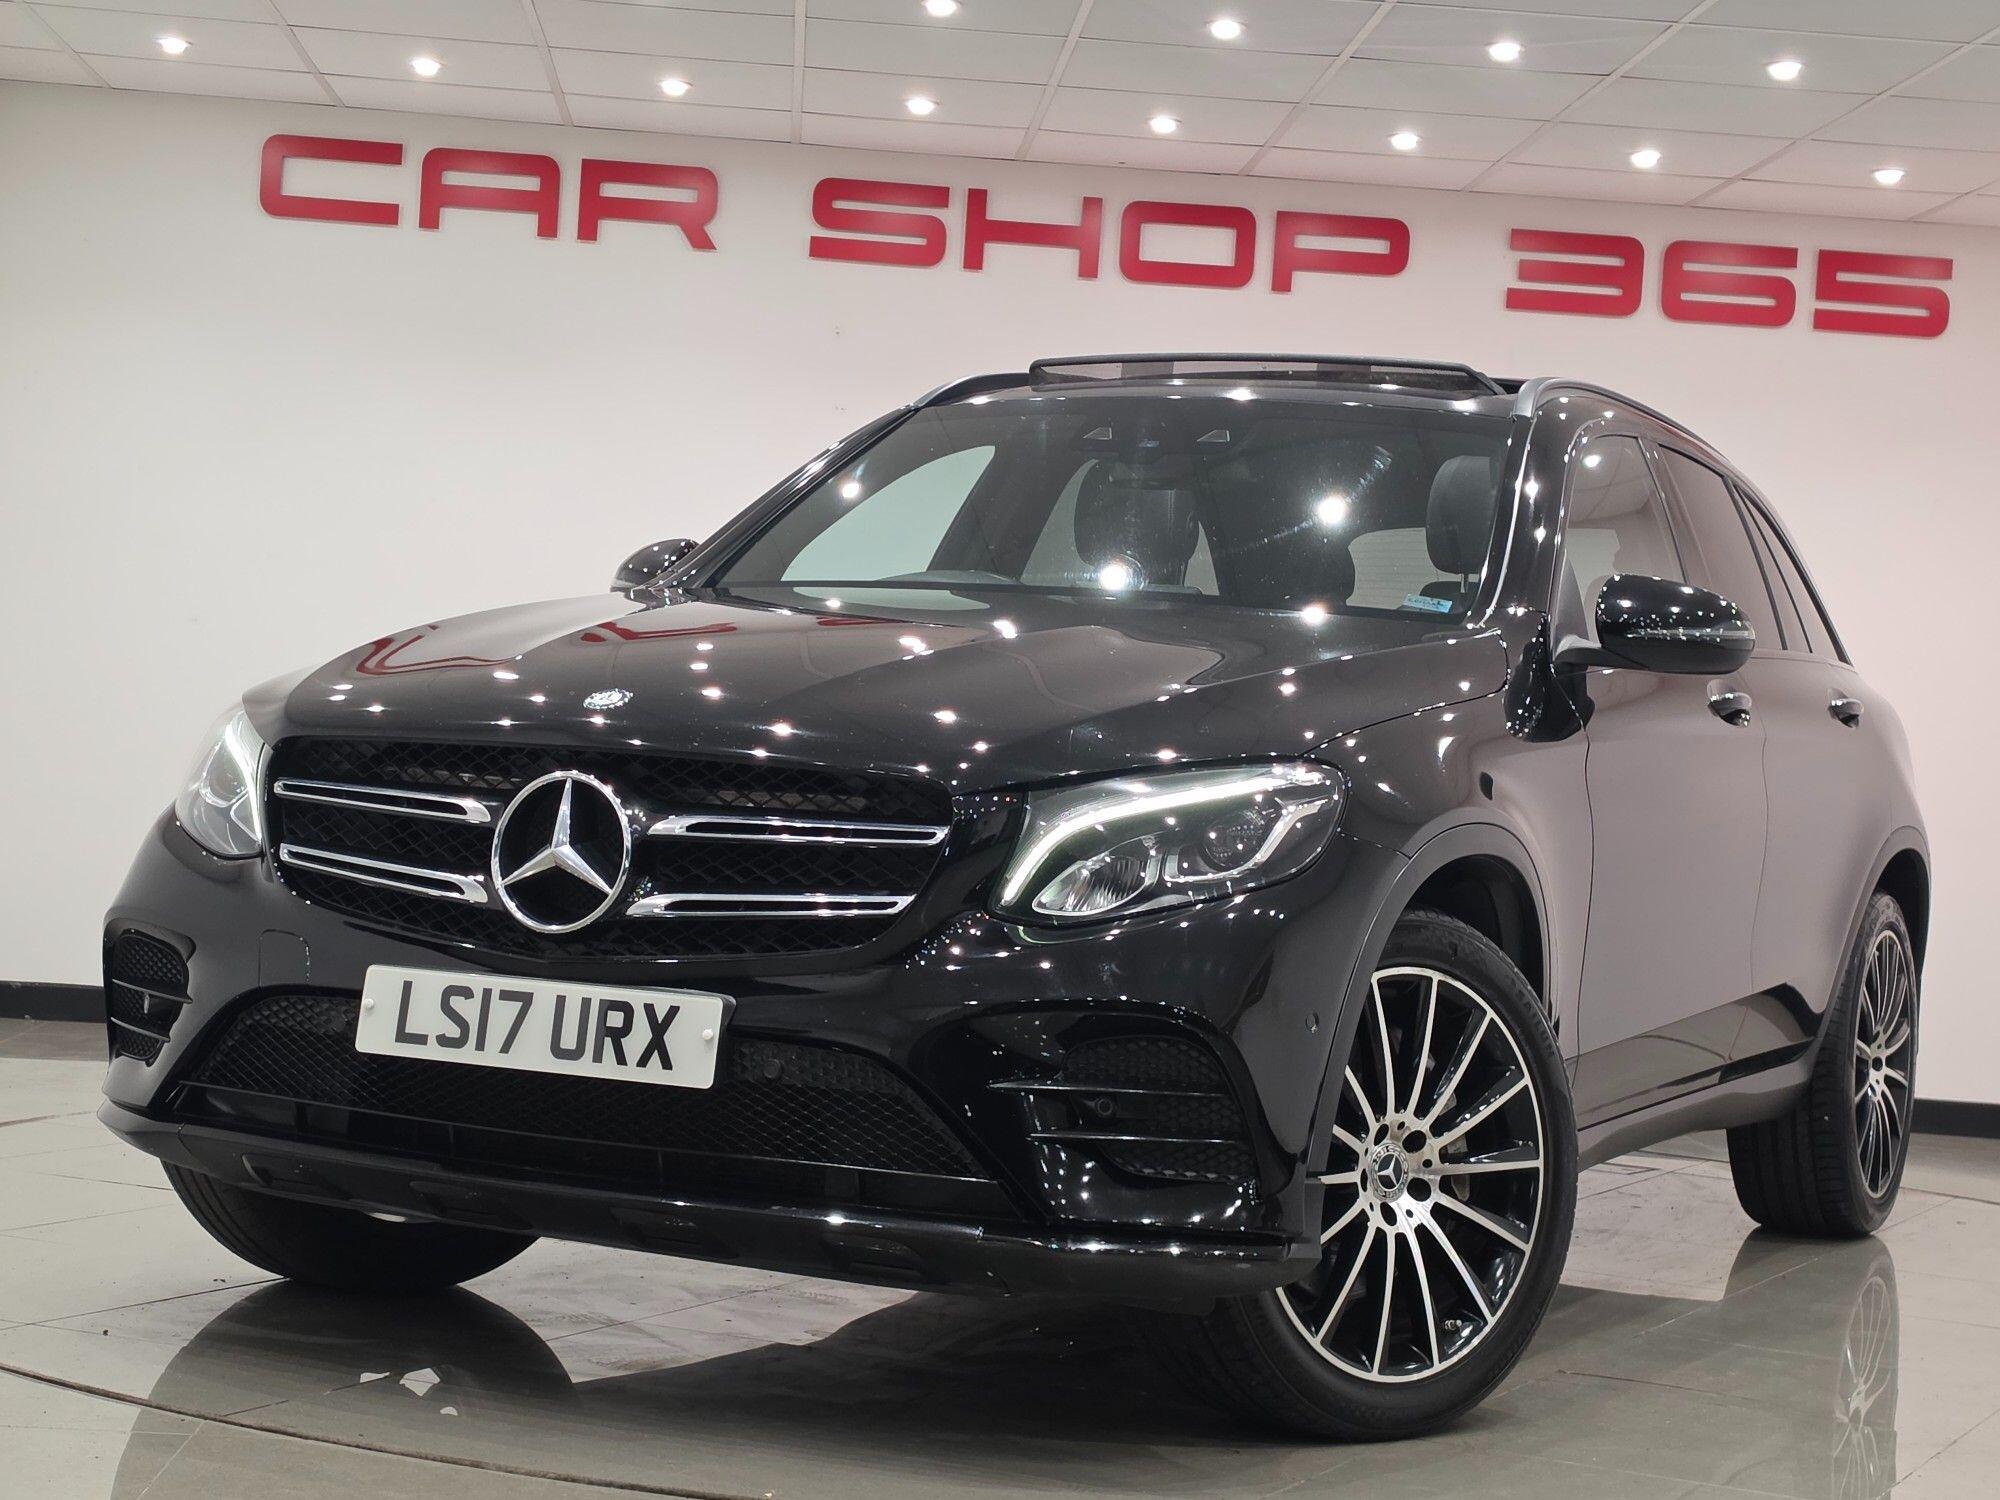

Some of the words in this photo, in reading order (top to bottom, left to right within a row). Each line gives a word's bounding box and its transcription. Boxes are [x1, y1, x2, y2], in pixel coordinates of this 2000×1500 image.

[260, 134, 718, 250] CAR
[809, 177, 1411, 292] SHOP
[1506, 228, 1954, 338] 365
[394, 979, 535, 1055] LS17
[549, 994, 681, 1072] URX
